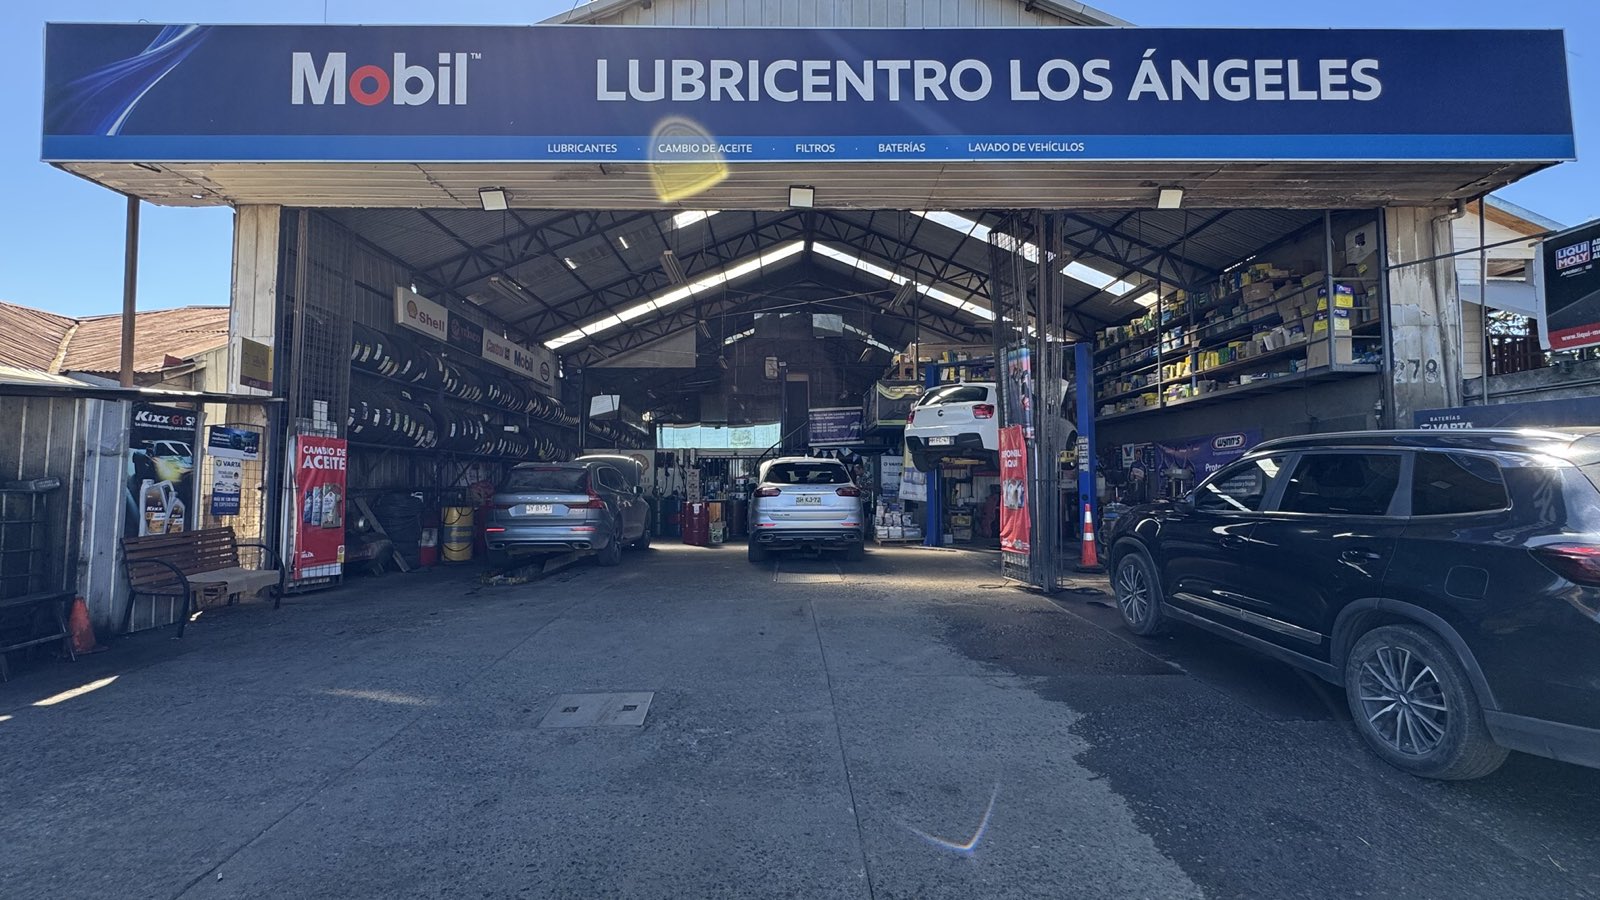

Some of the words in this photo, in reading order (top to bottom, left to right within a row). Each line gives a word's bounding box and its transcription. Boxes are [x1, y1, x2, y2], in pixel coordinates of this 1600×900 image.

[291, 51, 468, 106] Mobil
[596, 57, 993, 103] LUBRICENTRO
[1009, 57, 1113, 103] LOS
[1127, 47, 1383, 103] ÁNGELES
[546, 143, 618, 153] LUBRICANTES
[657, 143, 700, 153] CAMBIO
[701, 143, 716, 153] DE
[717, 143, 753, 153] ACEITE
[795, 143, 835, 153] FILTROS
[878, 141, 926, 153] BATERÍAS
[968, 143, 1009, 152] LAVADO
[1012, 143, 1026, 152] DE
[1028, 141, 1085, 152] VEHÍCULOS
[1558, 243, 1587, 259] LIQUI
[1558, 252, 1588, 269] MOLY
[419, 311, 445, 333] Shell
[135, 410, 170, 424] Kixx
[1429, 414, 1461, 422] BATERÍAS
[303, 446, 335, 456] CAMBIO
[336, 448, 346, 457] DE
[303, 456, 346, 470] ACEITE
[1205, 463, 1225, 473] Prote
